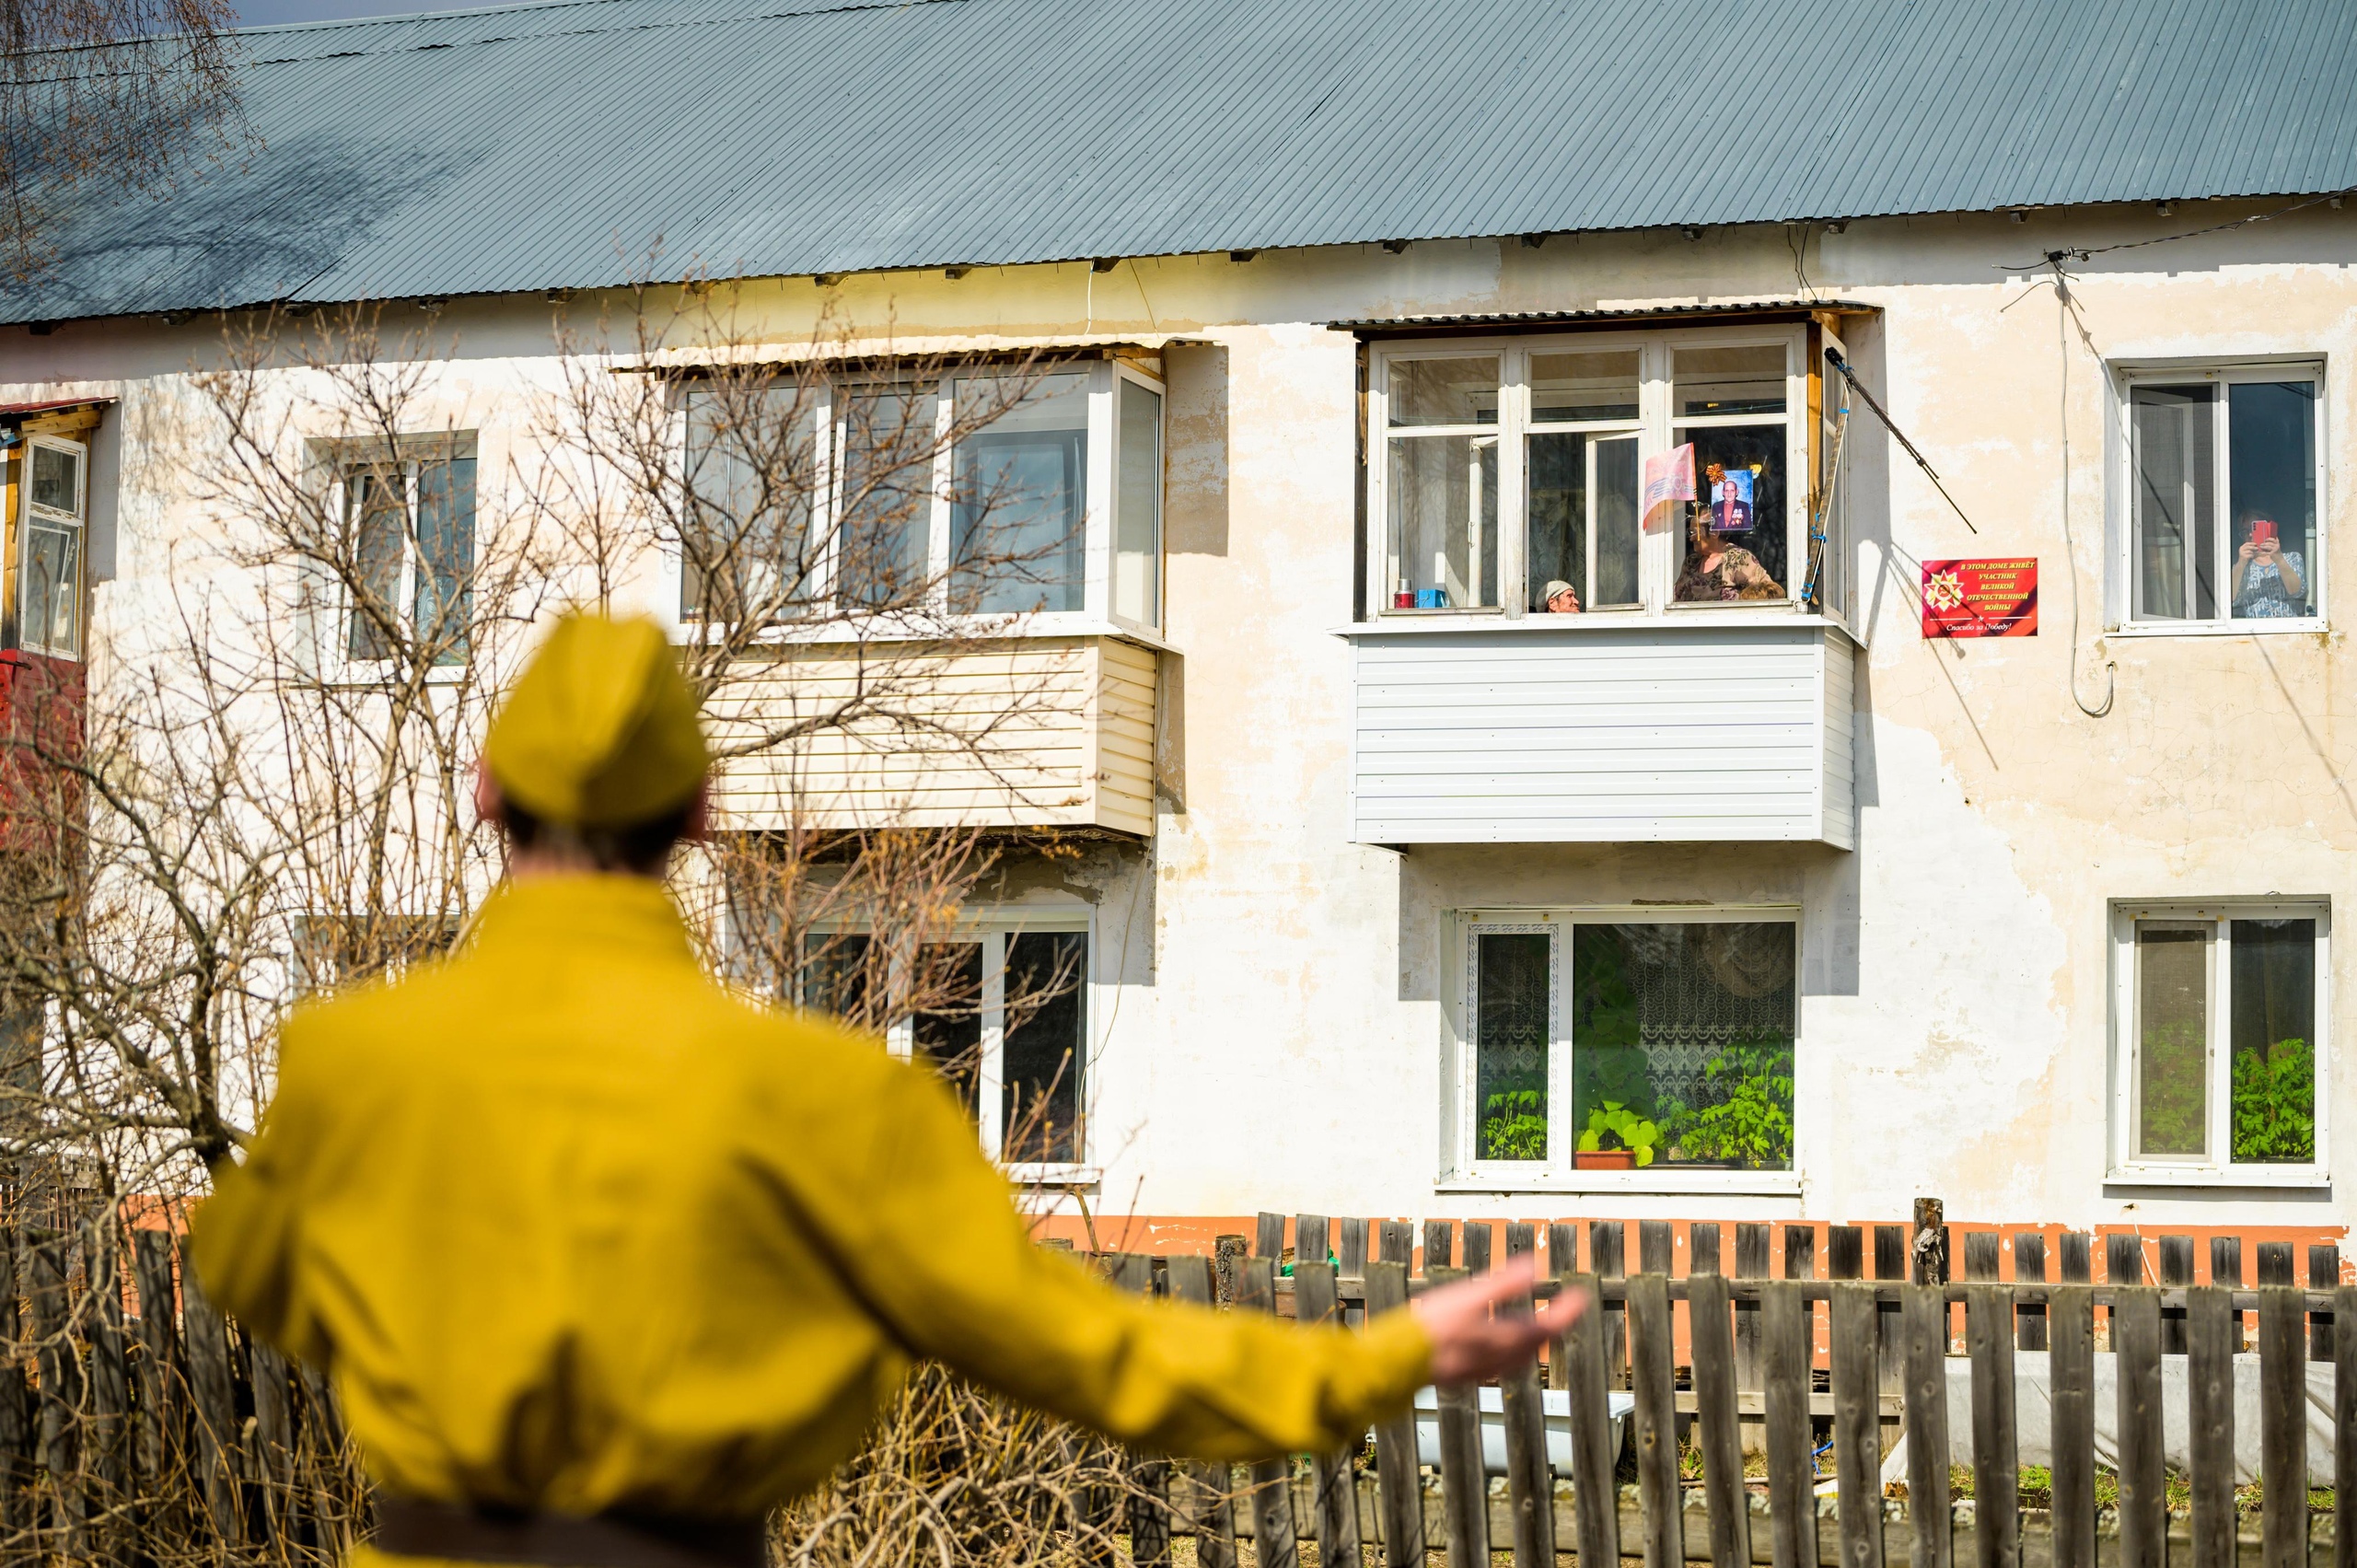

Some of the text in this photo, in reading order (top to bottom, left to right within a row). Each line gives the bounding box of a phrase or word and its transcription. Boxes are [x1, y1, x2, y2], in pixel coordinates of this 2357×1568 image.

[1980, 582, 2015, 590] ВЕЛИКОЙ
[1967, 592, 2029, 601] ОТЕЧЕСТВЕННОЙ
[1984, 603, 2011, 611] ВОЙНЫ
[1946, 623, 1974, 632] Спасибо
[1984, 622, 2012, 632] Победу!
